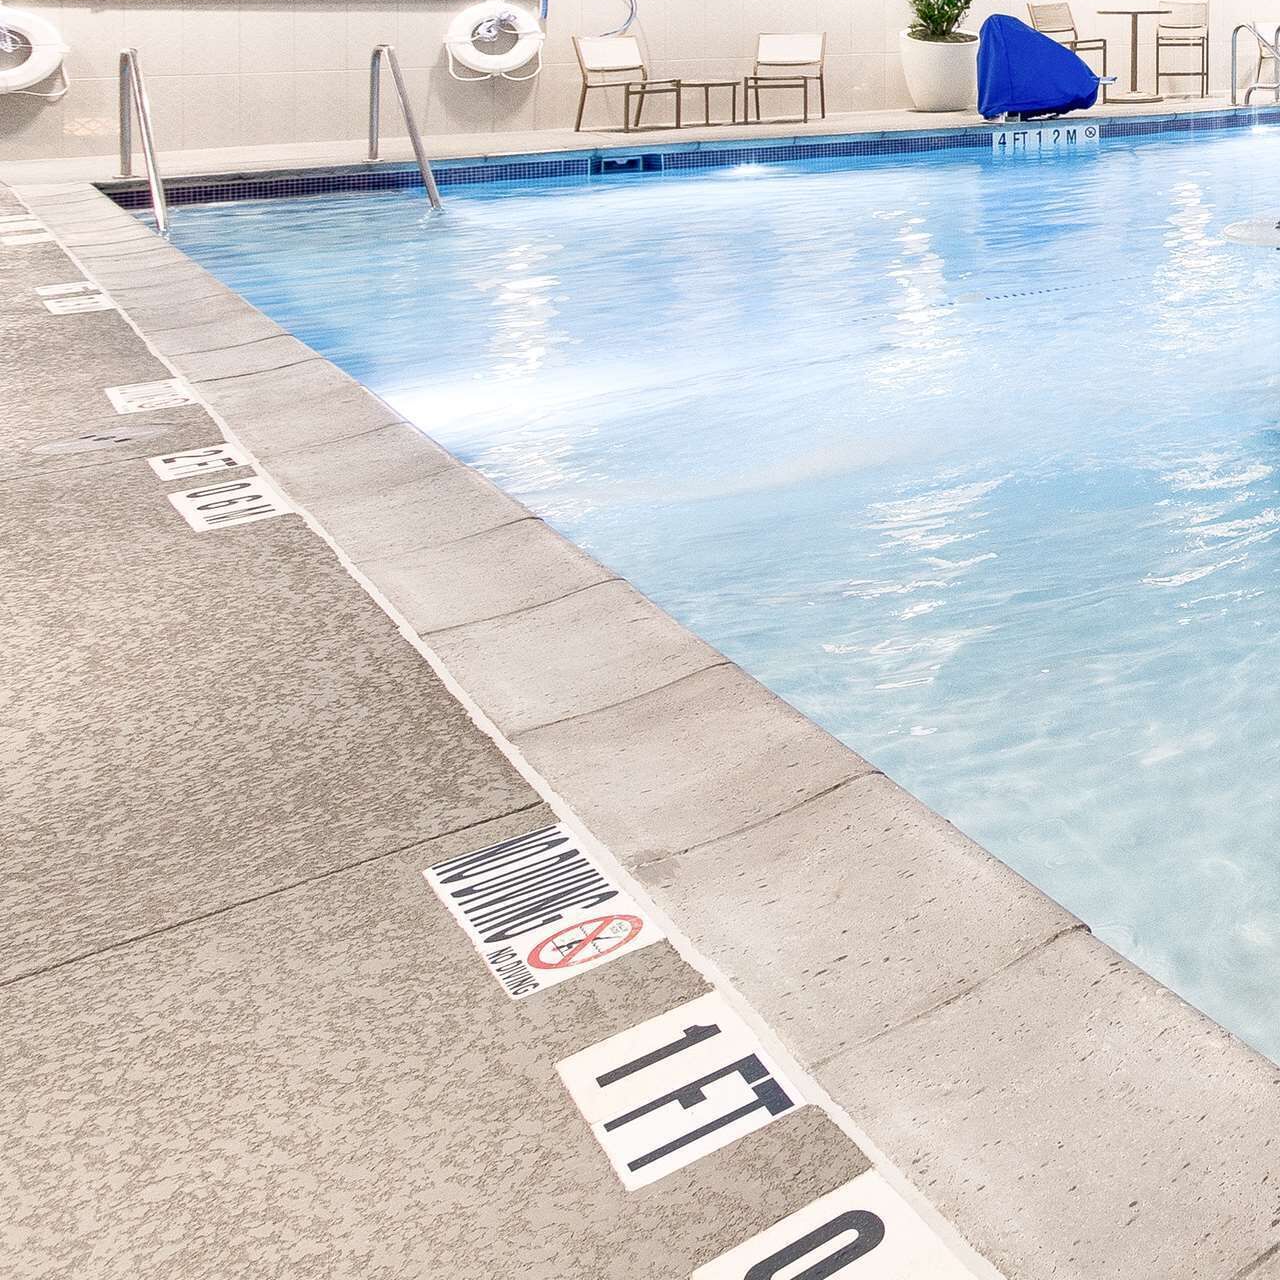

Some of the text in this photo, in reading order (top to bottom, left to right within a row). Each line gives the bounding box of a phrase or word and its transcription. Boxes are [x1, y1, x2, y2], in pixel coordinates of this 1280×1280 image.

[432, 825, 620, 944] NO DIVING
[486, 945, 540, 996] NO DIVING
[595, 1024, 795, 1172] 1 FT
